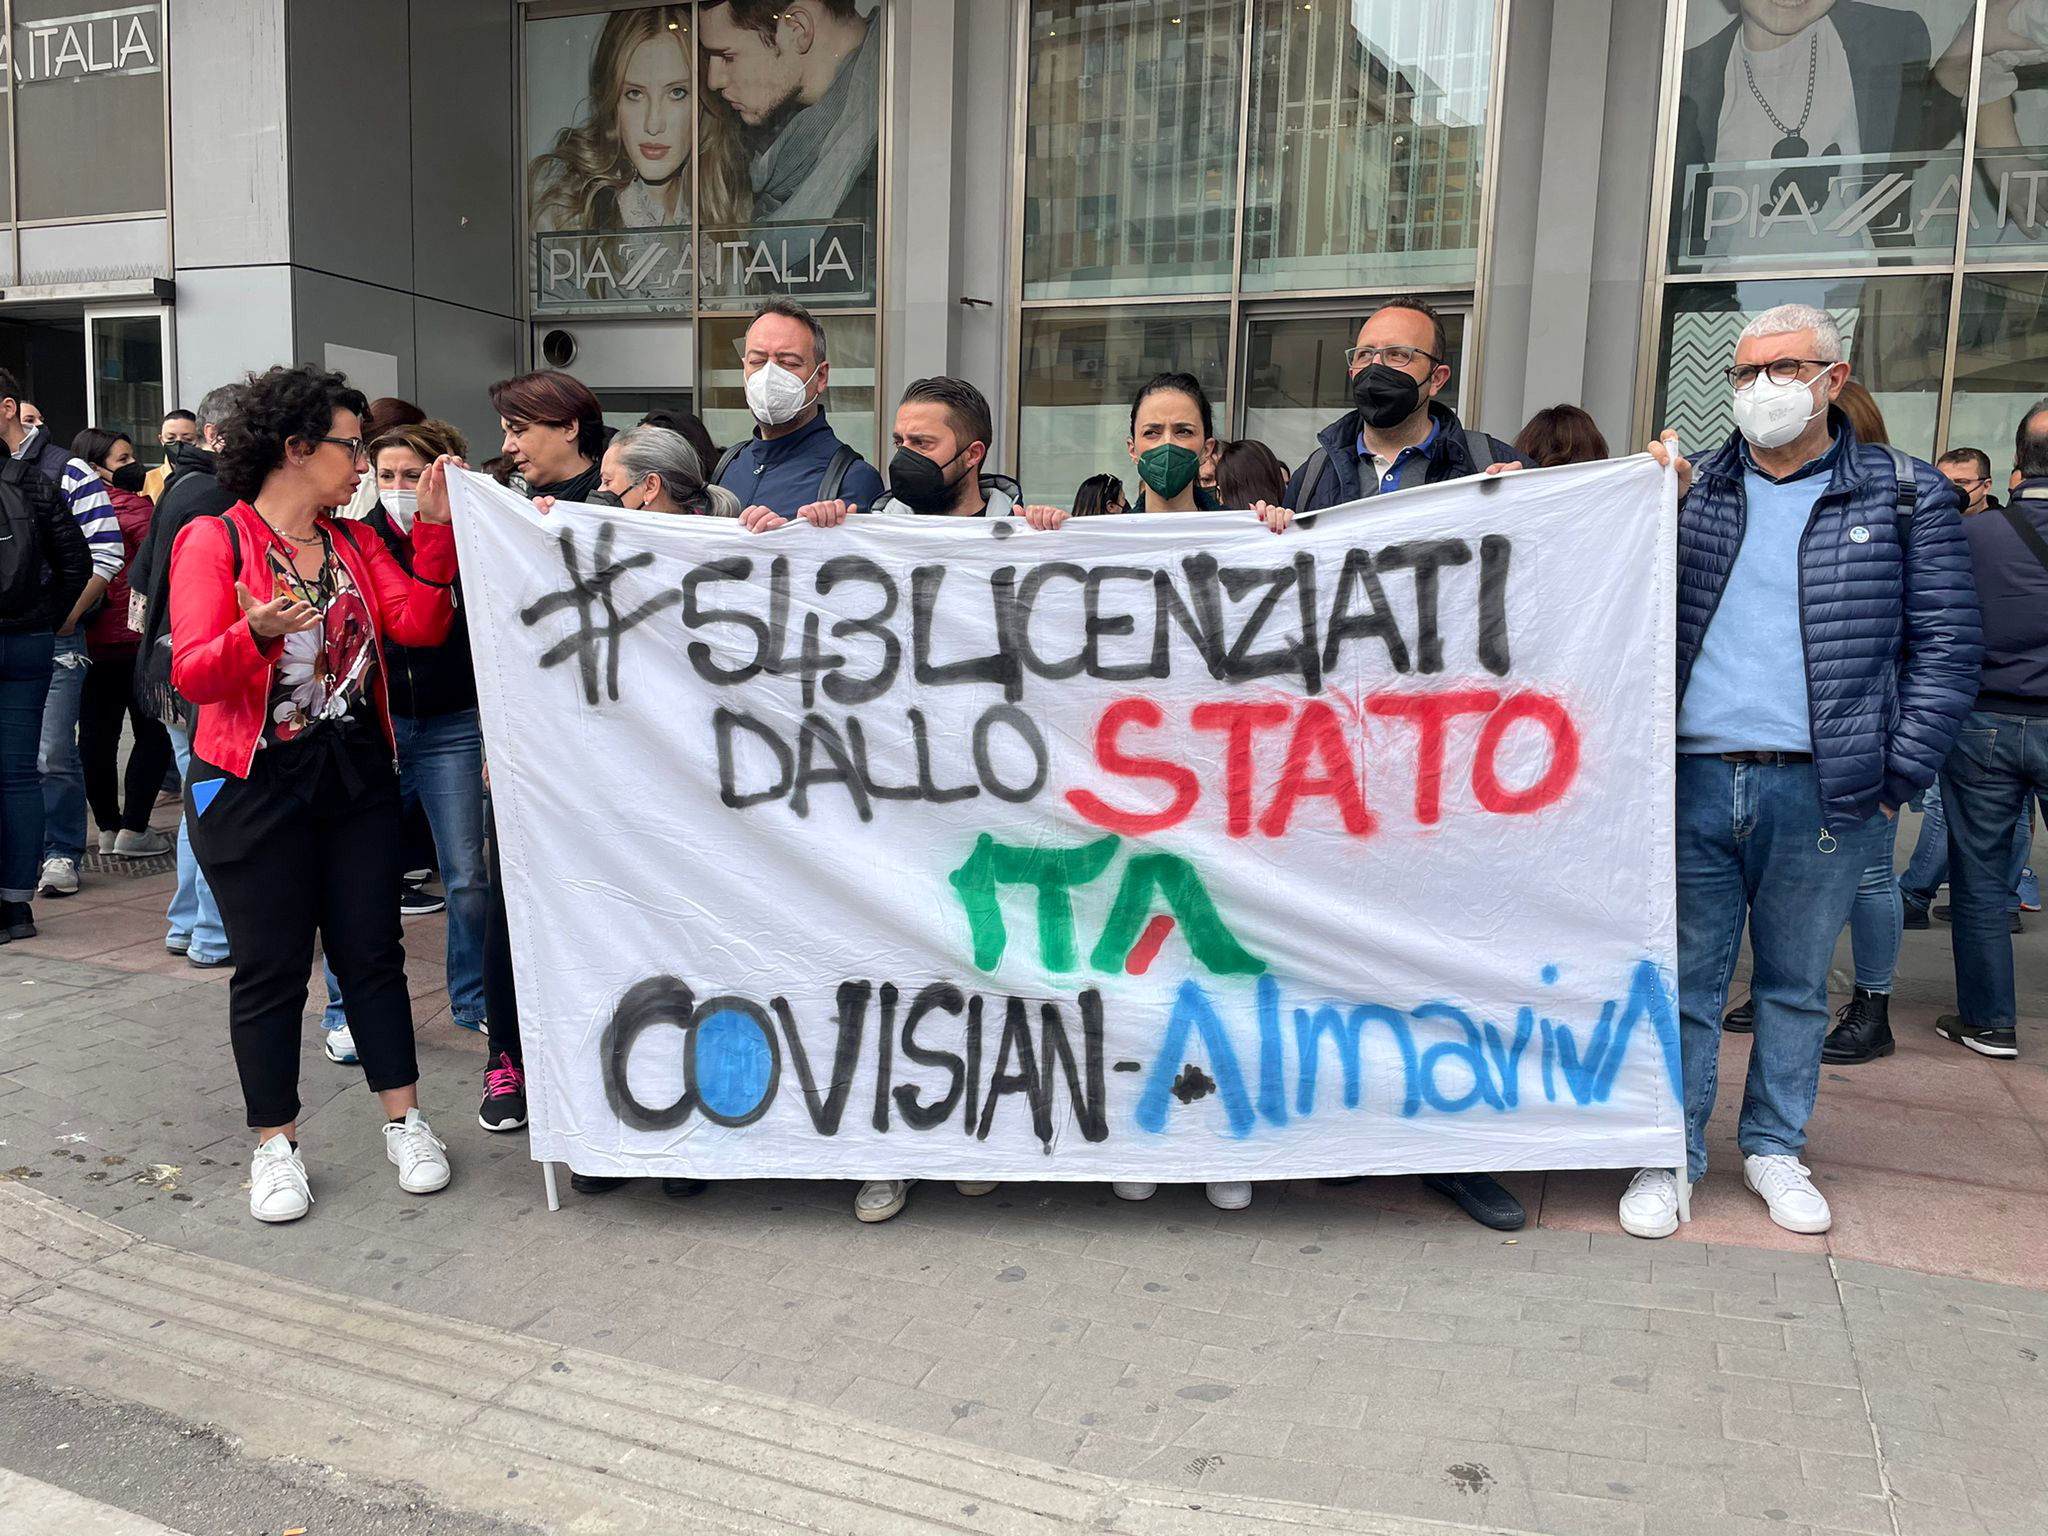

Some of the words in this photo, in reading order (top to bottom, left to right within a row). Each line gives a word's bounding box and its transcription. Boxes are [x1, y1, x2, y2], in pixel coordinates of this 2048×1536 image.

[28, 15, 154, 79] ITALIA
[1703, 172, 1980, 241] PIAZZA
[1997, 170, 2048, 229] IT
[549, 242, 708, 291] PIAZZA
[716, 236, 855, 286] ITALIA
[713, 703, 1049, 823] DALLO
[1065, 688, 1581, 838] STATO
[948, 832, 1268, 975] ITA
